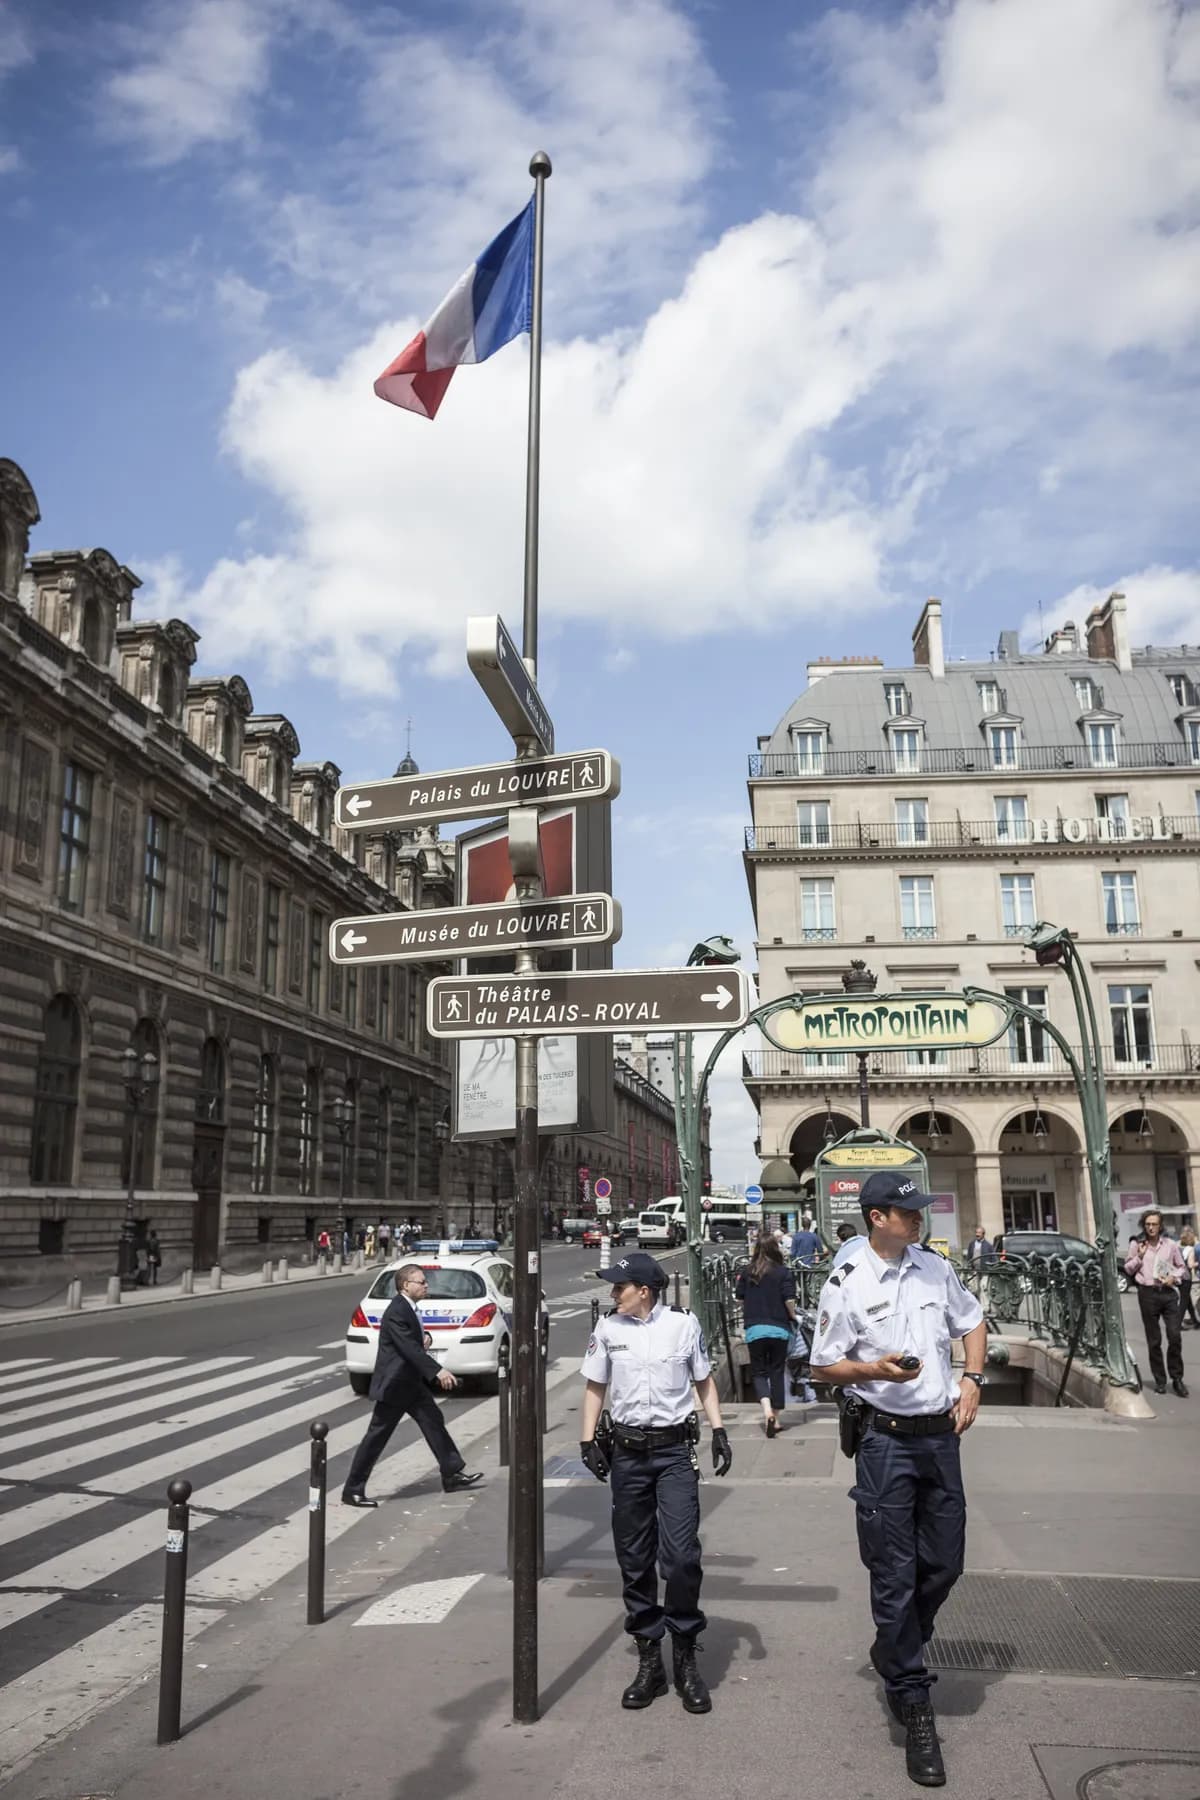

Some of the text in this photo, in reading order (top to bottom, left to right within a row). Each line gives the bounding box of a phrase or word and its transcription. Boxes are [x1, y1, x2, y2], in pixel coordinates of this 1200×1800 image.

[409, 768, 571, 806] Palais du LOUVRE
[1032, 816, 1172, 843] HOTEL
[400, 912, 571, 945] Musée du LOUVRE
[476, 985, 552, 1004] Théâtre
[475, 1001, 662, 1025] du PALAIS-ROYAL
[804, 1003, 969, 1040] METROPOLITAIN
